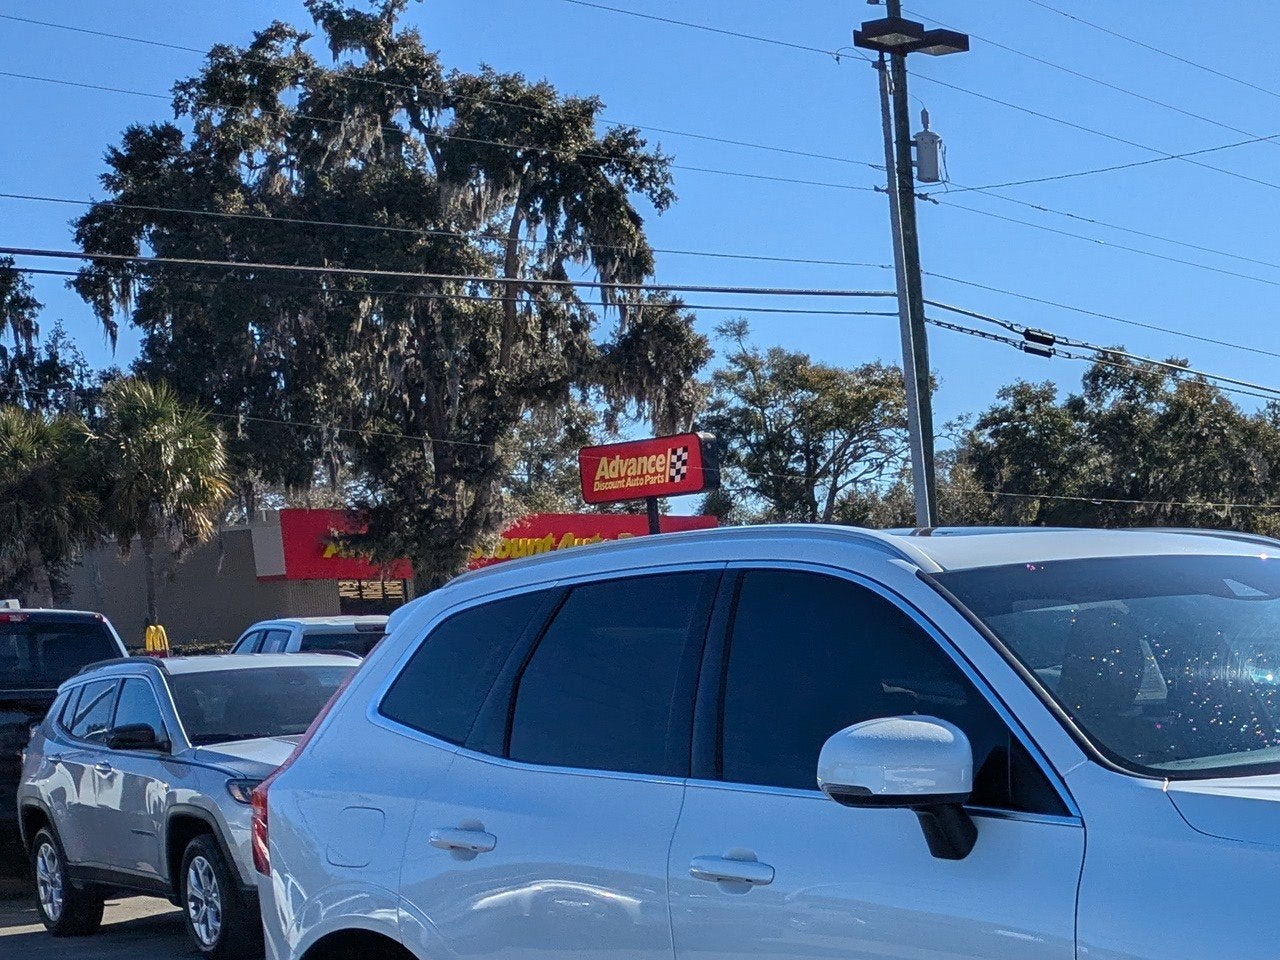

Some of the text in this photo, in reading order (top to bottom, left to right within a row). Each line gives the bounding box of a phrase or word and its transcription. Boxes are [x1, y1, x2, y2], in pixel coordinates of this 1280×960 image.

[594, 453, 666, 481] Advance
[593, 474, 665, 492] Discount Auto Parts
